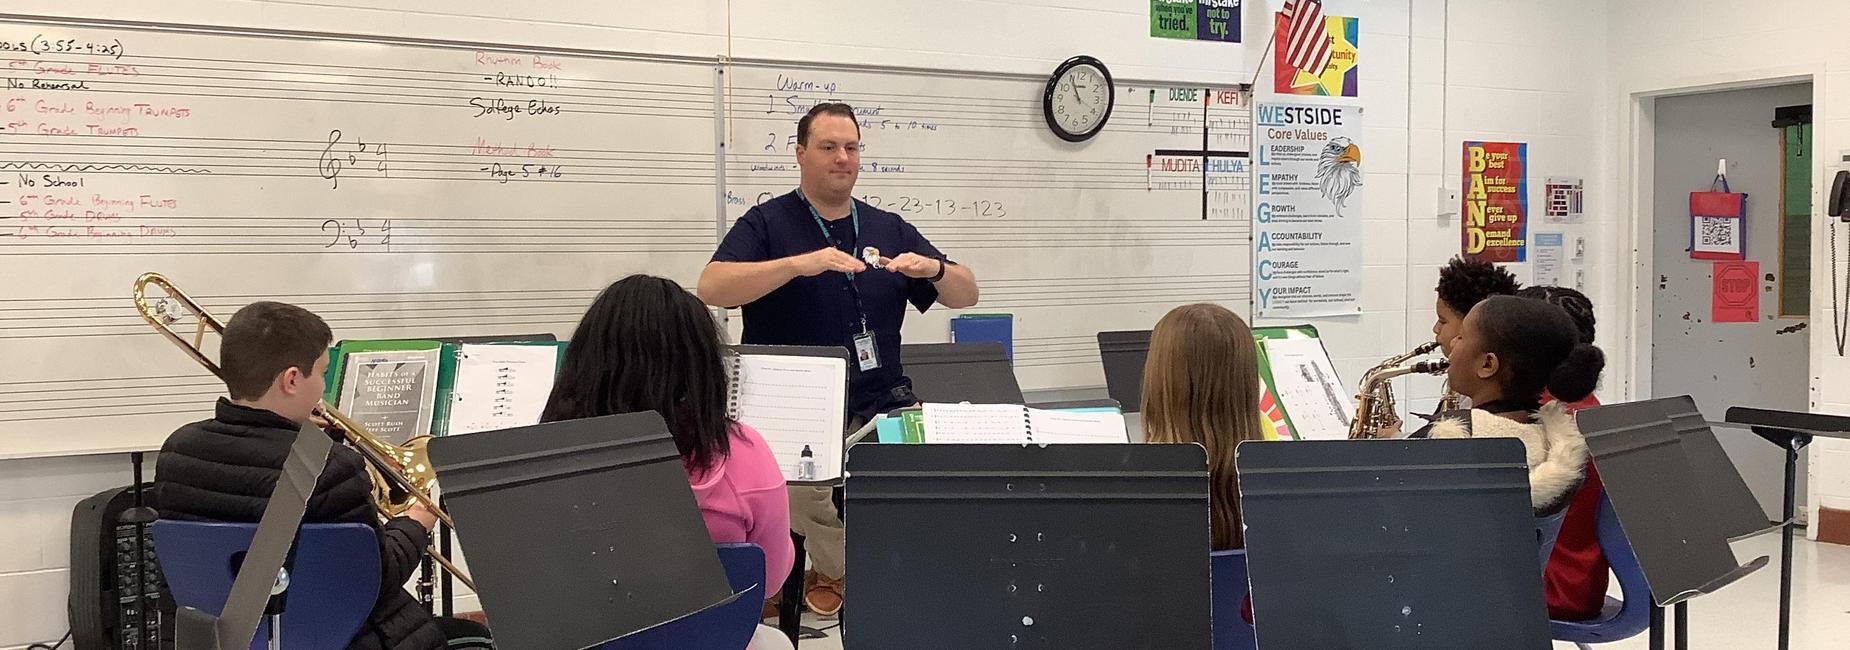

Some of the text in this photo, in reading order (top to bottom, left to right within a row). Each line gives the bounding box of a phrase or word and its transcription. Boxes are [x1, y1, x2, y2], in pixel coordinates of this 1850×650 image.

[1207, 9, 1230, 19] not to
[1159, 14, 1189, 31] tried.
[1210, 20, 1228, 39] try.
[1332, 49, 1356, 63] tunity
[7, 77, 24, 91] No
[1169, 88, 1198, 102] DUENDE
[1216, 91, 1239, 105] KEFI
[36, 100, 75, 114] Grade
[1258, 105, 1342, 126] WESTSIDE
[37, 122, 78, 136] Grade
[1268, 128, 1328, 141] Core Values
[764, 132, 776, 151] 2
[1491, 152, 1508, 162] your
[522, 164, 534, 177] 5
[871, 162, 878, 173] 8
[1161, 158, 1200, 172] MUDITA
[1212, 159, 1244, 173] HULYA
[1488, 159, 1505, 169] best
[19, 174, 84, 187] No School
[1495, 176, 1506, 185] for
[43, 195, 81, 206] Grade
[1488, 213, 1517, 224] give up
[1486, 237, 1525, 247] excellence
[1288, 286, 1311, 294] IMPACT
[1722, 279, 1750, 293] STOP
[364, 378, 416, 386] SUCCESSFUL
[366, 384, 412, 393] BEGINNER
